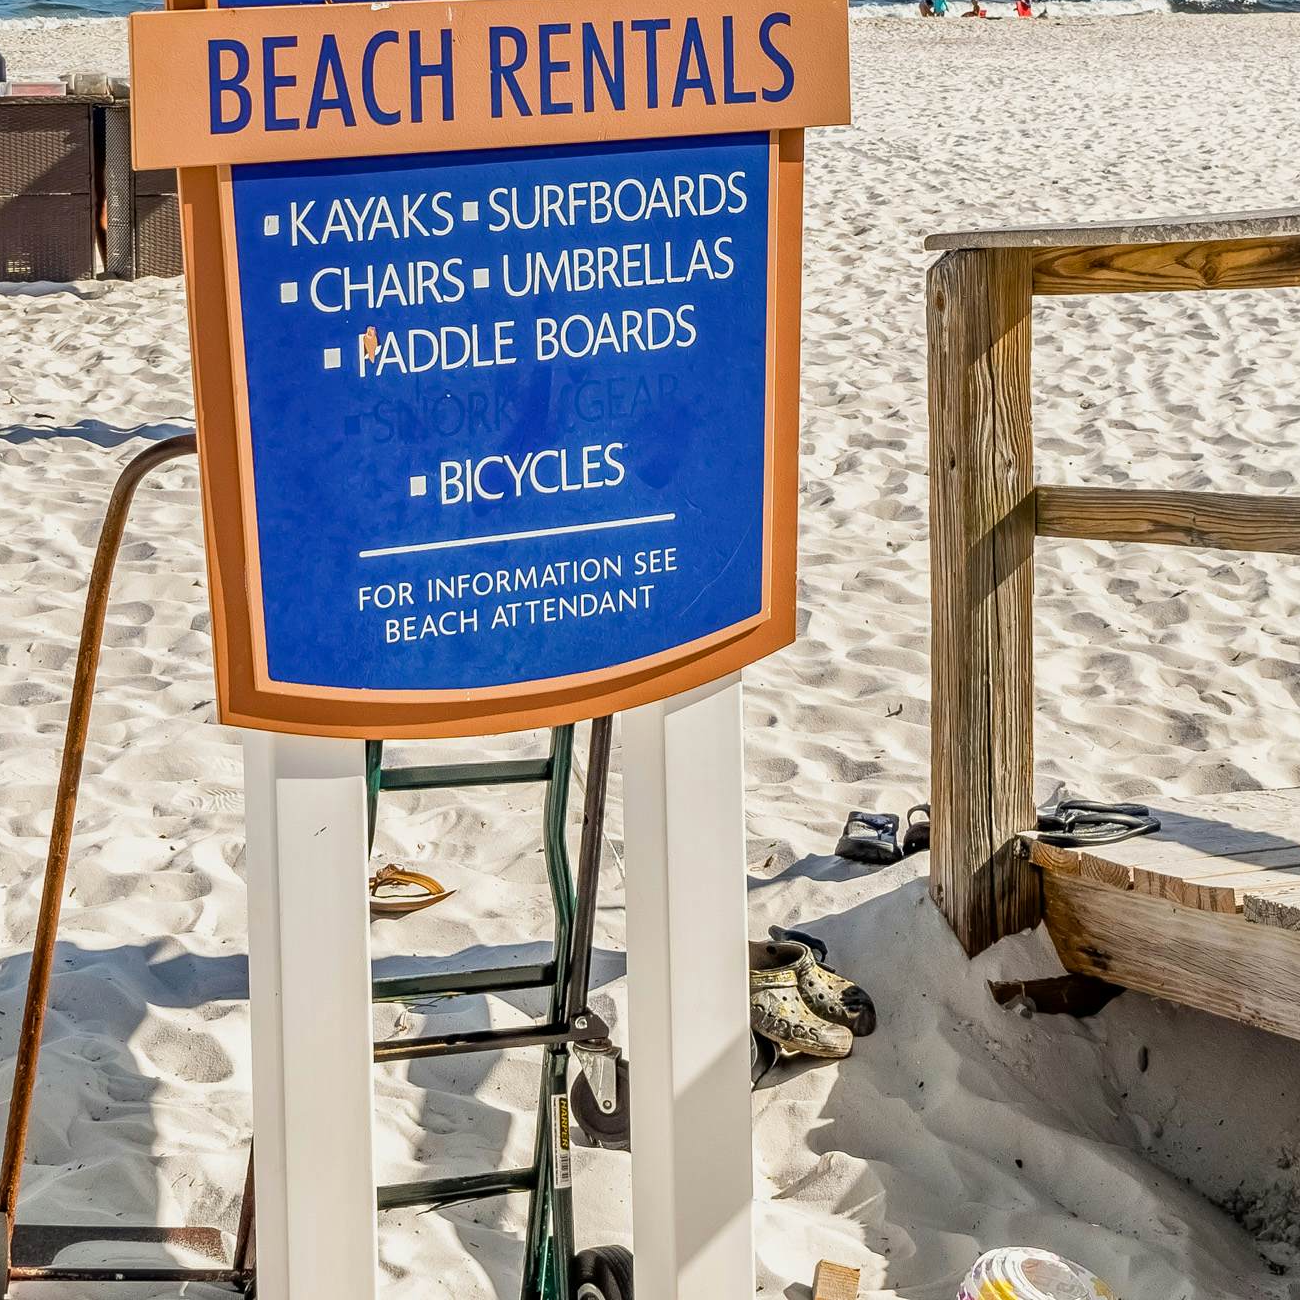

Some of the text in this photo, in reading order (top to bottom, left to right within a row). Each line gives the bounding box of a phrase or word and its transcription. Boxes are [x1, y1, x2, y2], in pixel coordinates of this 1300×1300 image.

[207, 12, 795, 135] BEACH RENTALS
[290, 171, 747, 246] KAYAKS SURFBOARDS
[310, 237, 735, 313] CHAIRS UMBRELLAS
[358, 305, 697, 378] PADDLE BOARDS
[440, 442, 626, 506] BICYCLES
[358, 548, 678, 612] FOR INFORMATION SEE
[384, 585, 654, 643] BEACH ATTENDANT
[560, 1099, 570, 1148] HARPER
